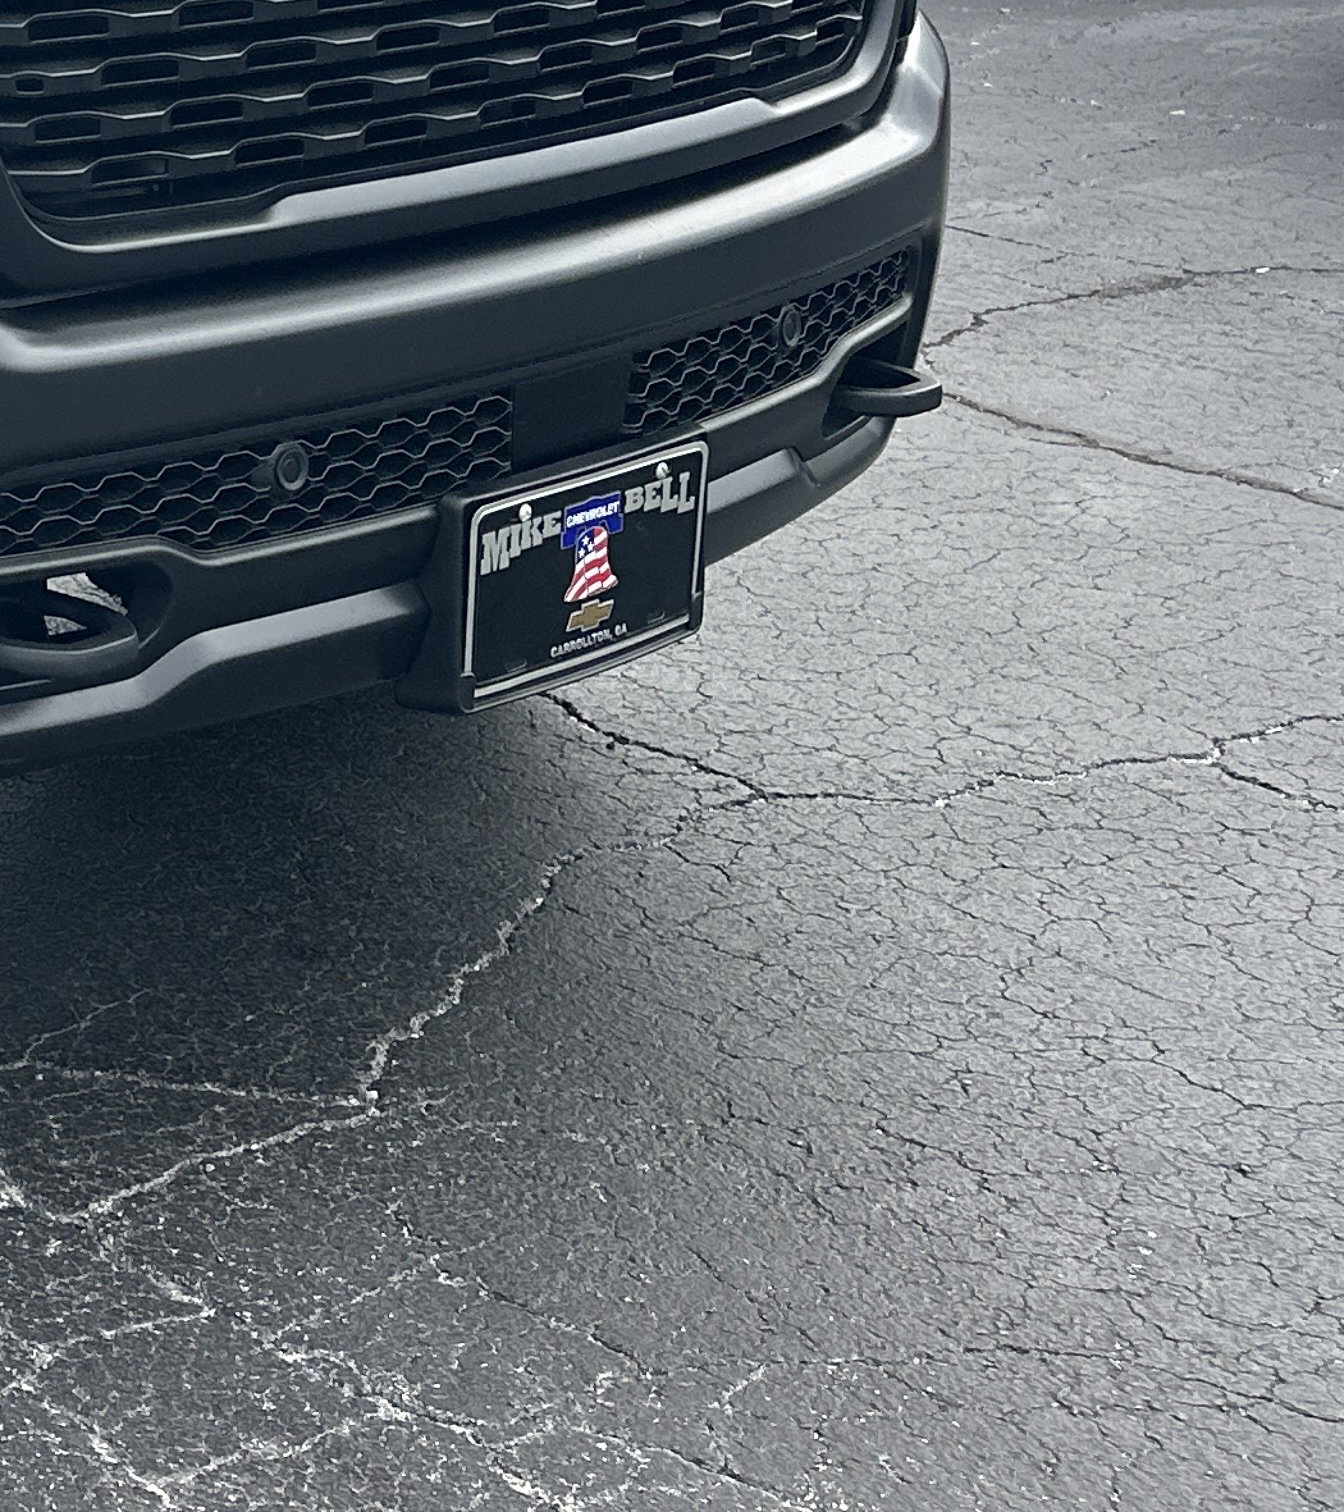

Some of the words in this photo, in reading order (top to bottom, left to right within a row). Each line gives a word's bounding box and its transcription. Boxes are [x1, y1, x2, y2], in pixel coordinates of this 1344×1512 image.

[479, 510, 563, 576] MIKE
[624, 471, 696, 515] BELL
[566, 500, 621, 528] CHEVROLET
[614, 622, 628, 637] GA
